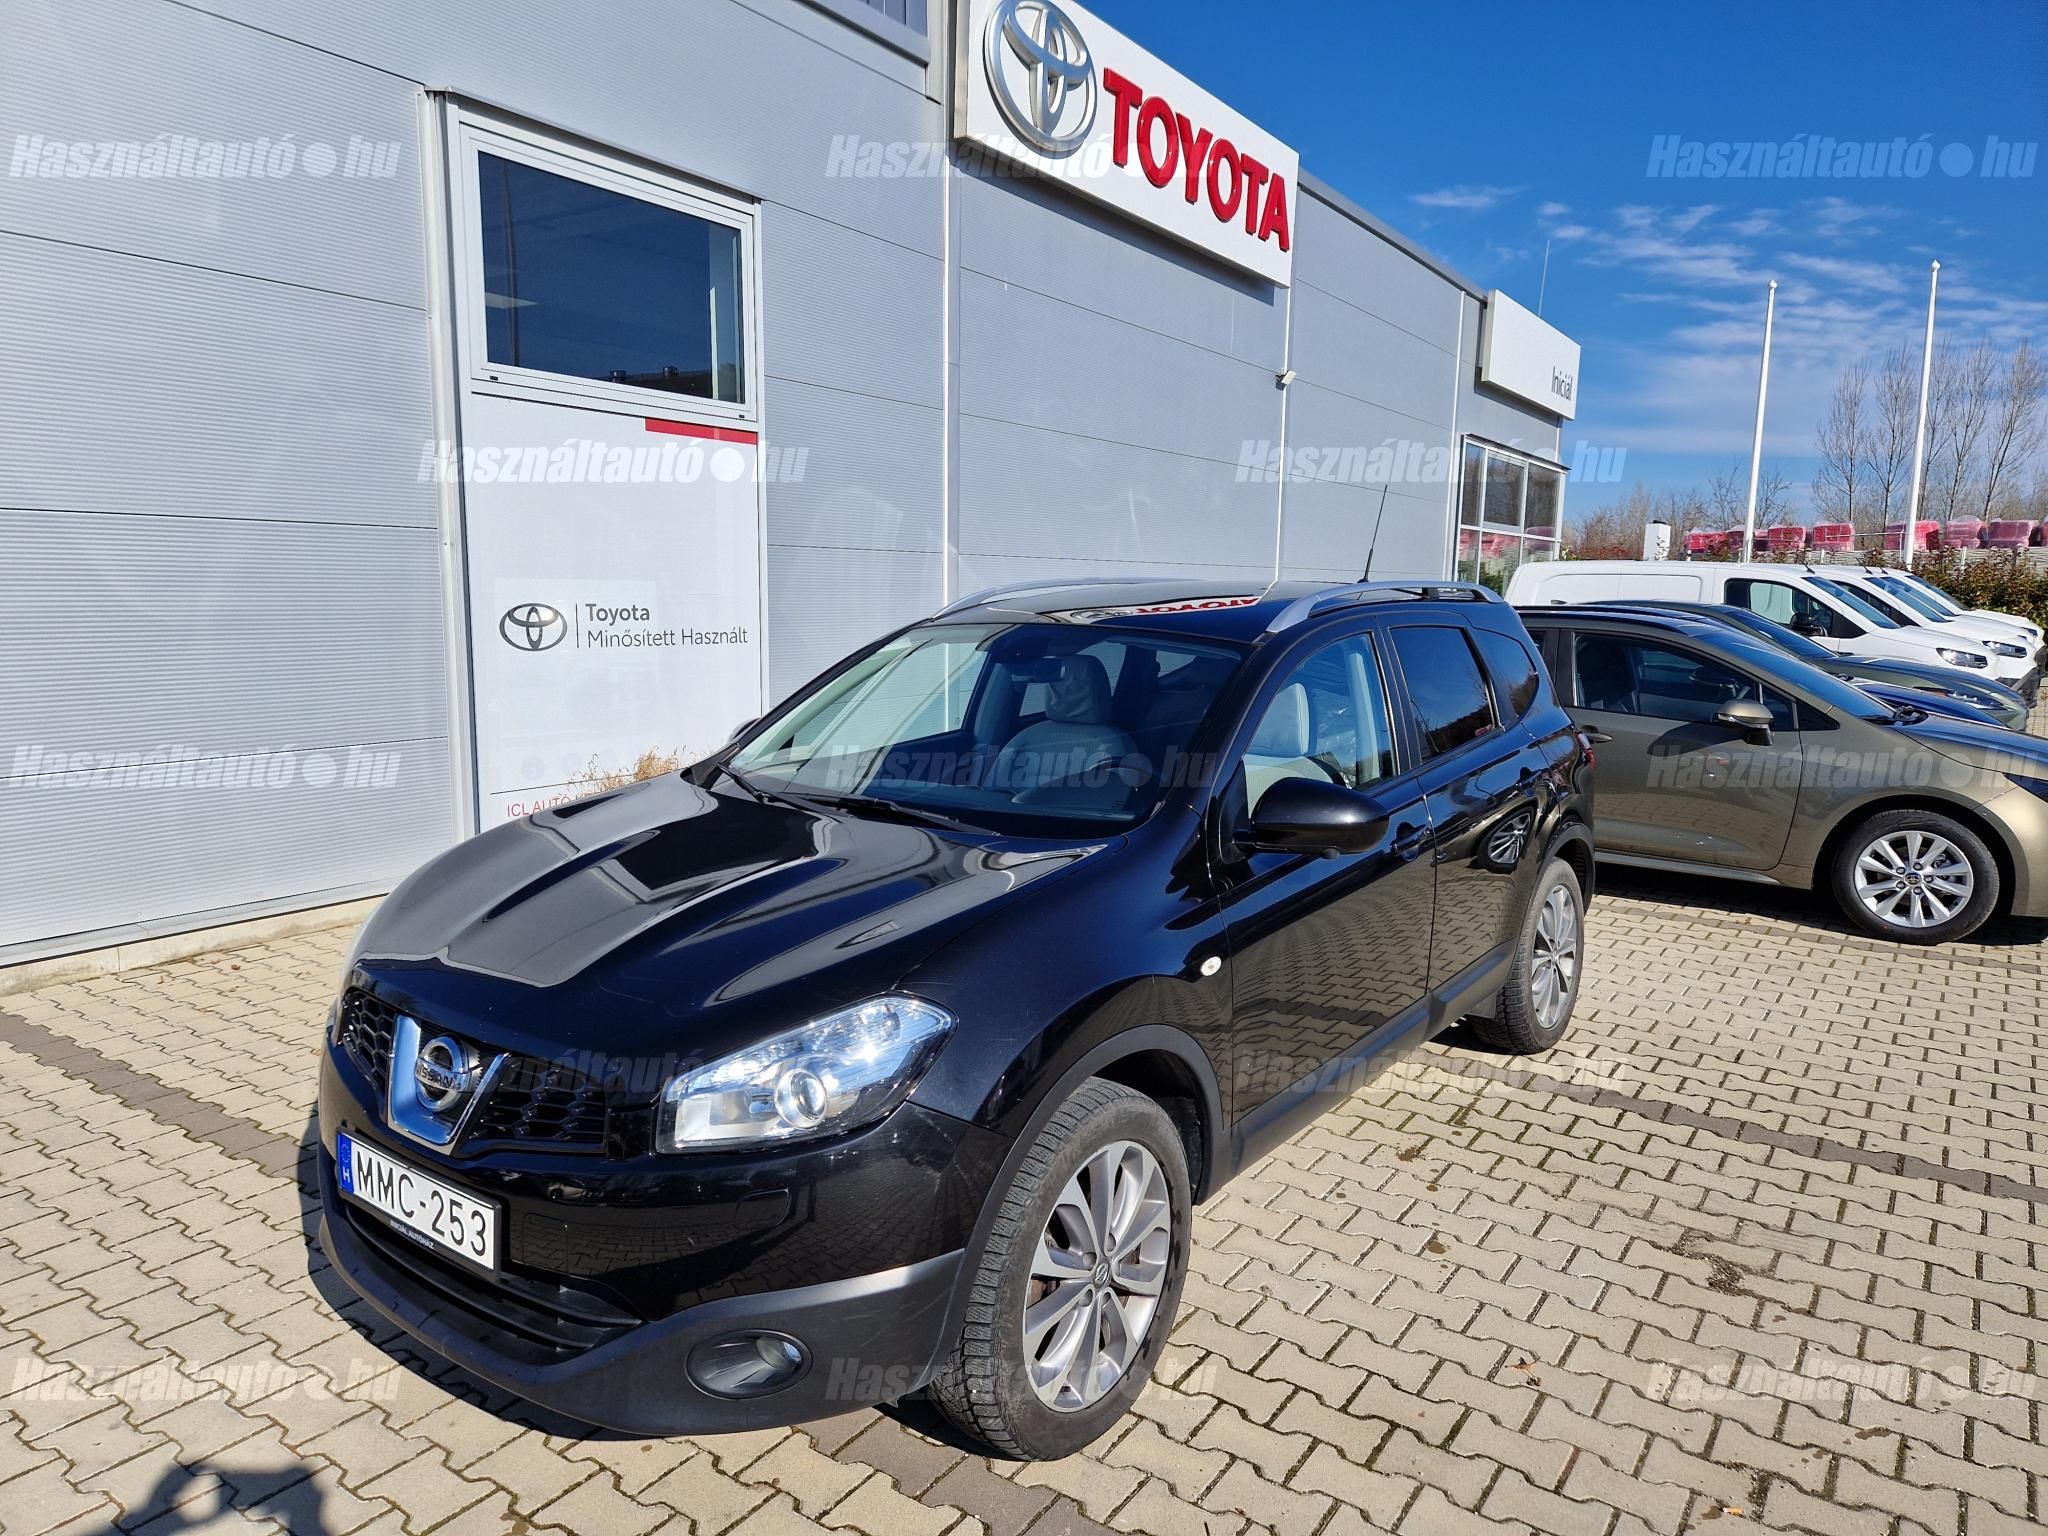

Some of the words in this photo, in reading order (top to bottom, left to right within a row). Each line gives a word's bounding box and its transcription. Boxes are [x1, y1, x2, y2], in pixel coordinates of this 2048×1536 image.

[1103, 67, 1289, 252] TOYOTA
[1551, 366, 1573, 401] Iniciál
[585, 603, 650, 626] Toyota
[588, 629, 676, 648] Minősített
[682, 626, 748, 646] Használt
[507, 803, 529, 817] ICL
[342, 1166, 351, 1183] H
[356, 1153, 488, 1257] MMC-253
